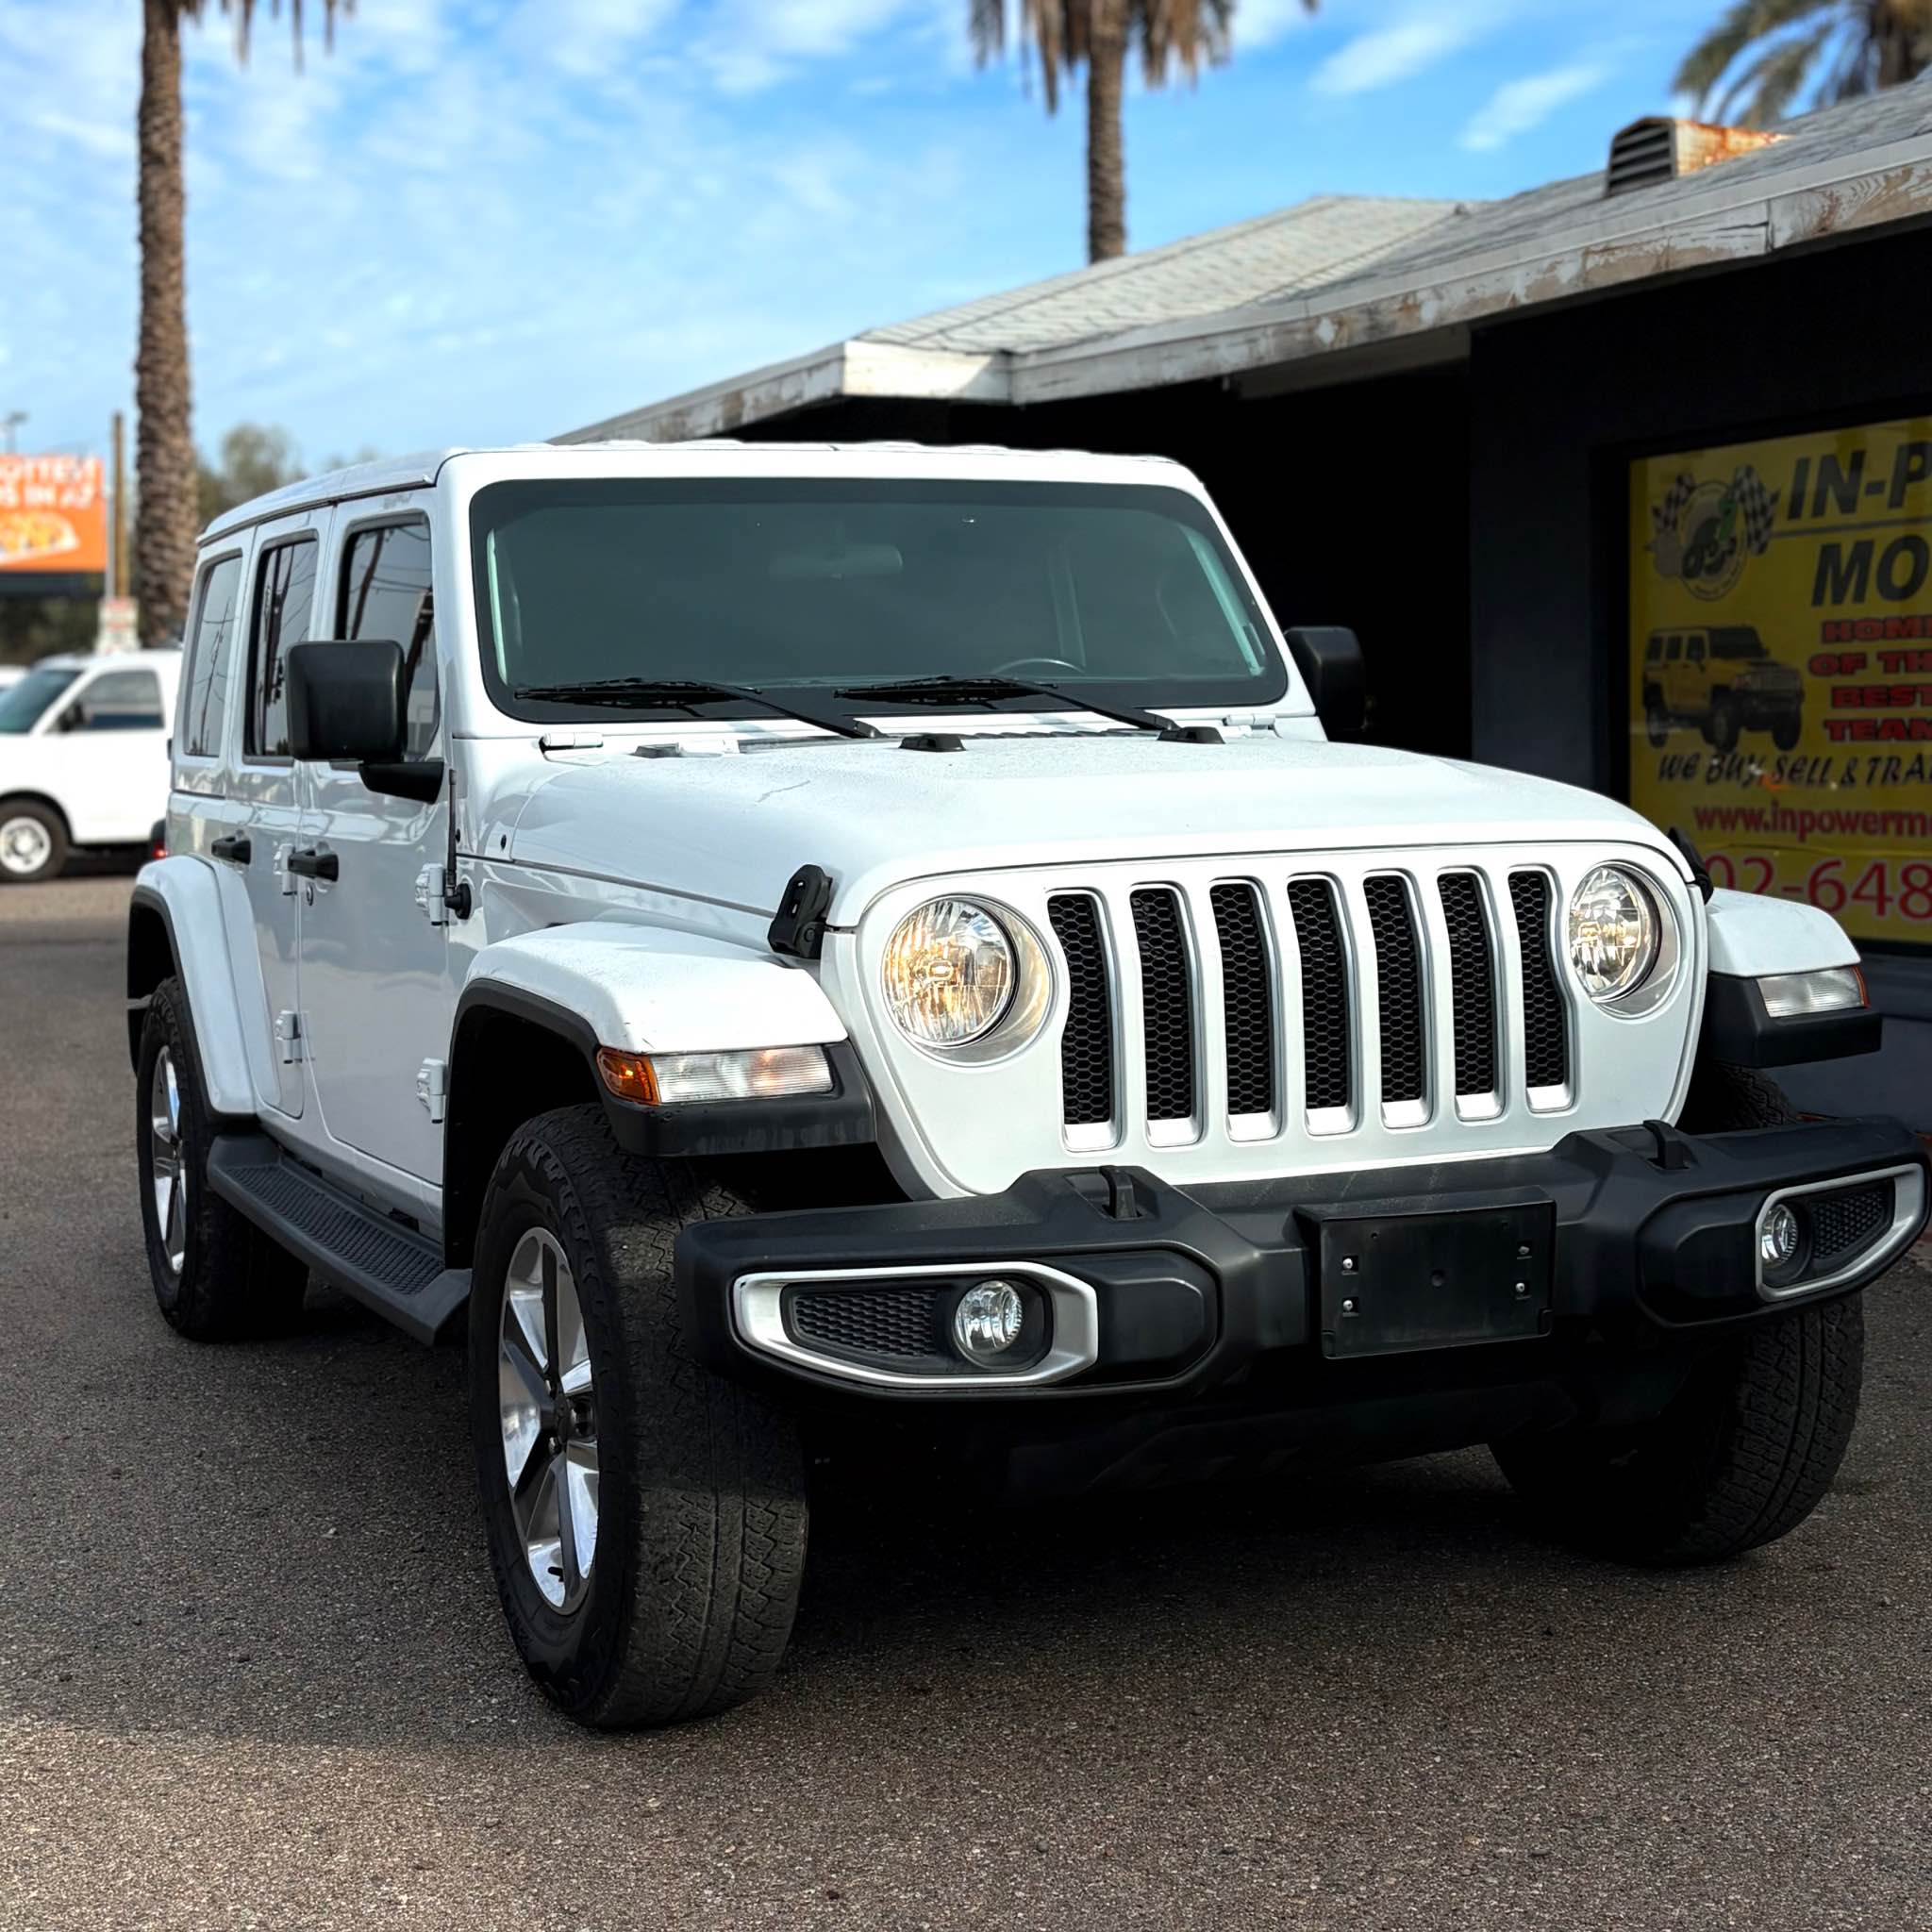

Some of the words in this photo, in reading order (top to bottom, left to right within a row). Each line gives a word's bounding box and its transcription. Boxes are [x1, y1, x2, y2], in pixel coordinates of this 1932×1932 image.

[1788, 441, 1932, 520] IN-P
[1811, 535, 1930, 608] MO
[1807, 652, 1867, 677] OF
[1831, 684, 1932, 709] BEST
[1840, 757, 1857, 785] &
[1866, 752, 1932, 786] TRA
